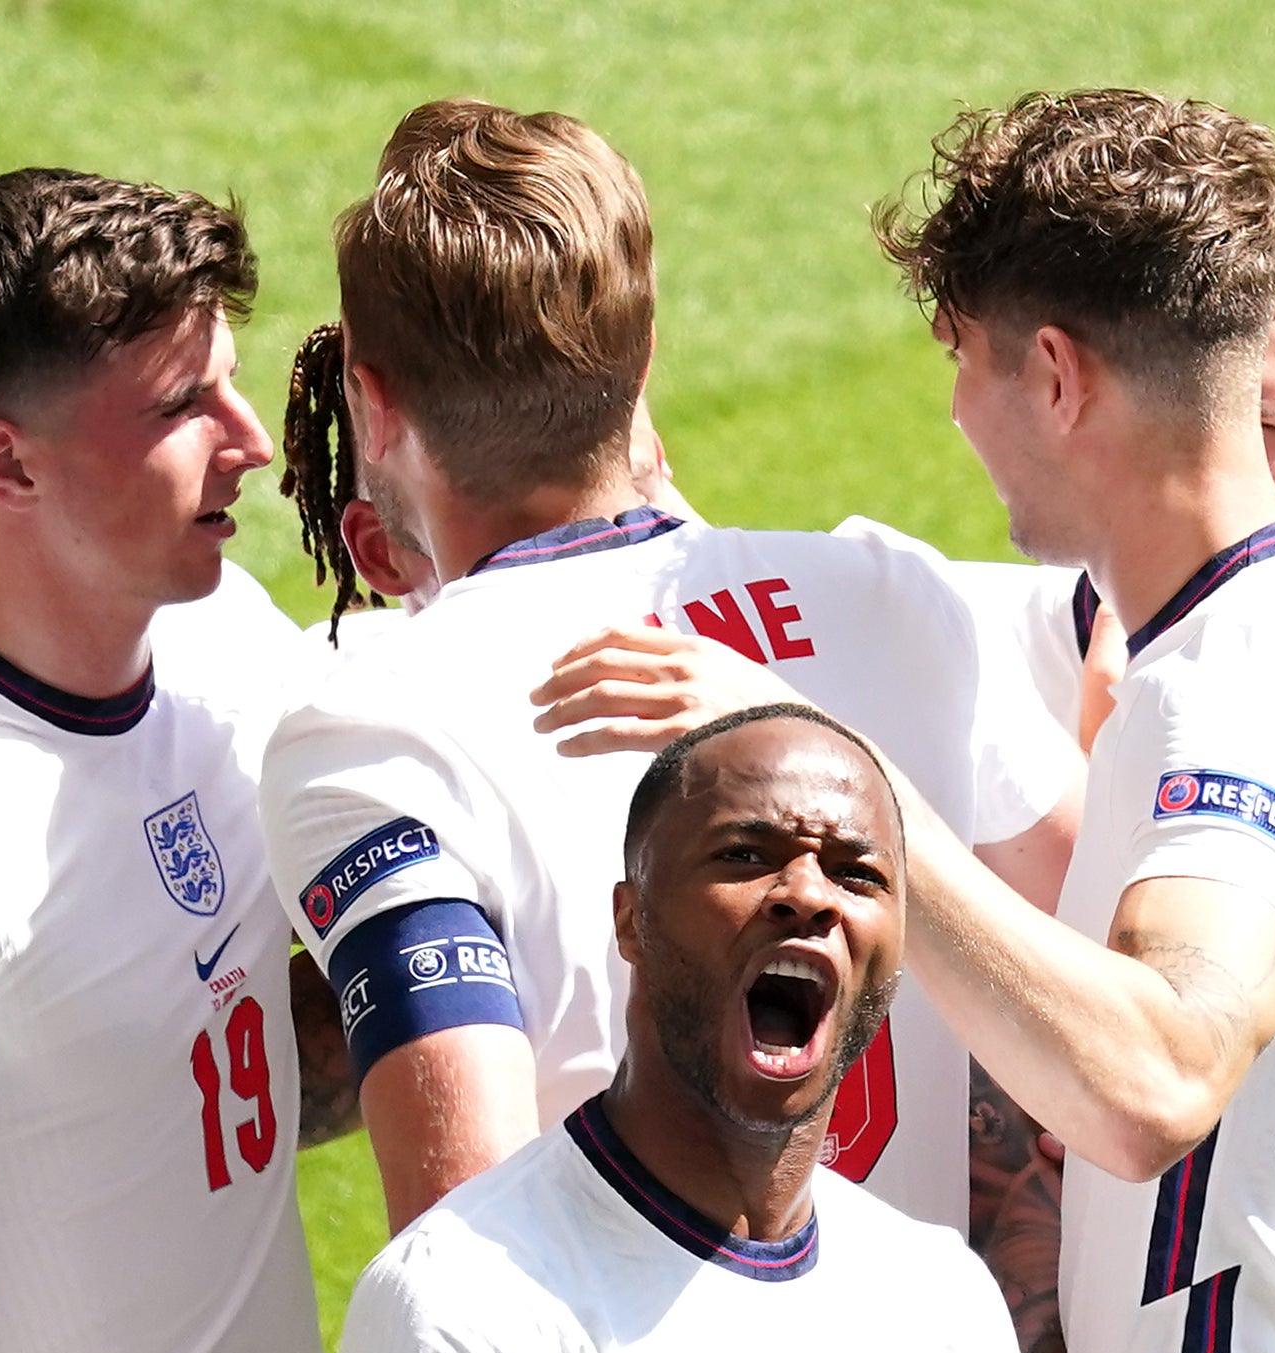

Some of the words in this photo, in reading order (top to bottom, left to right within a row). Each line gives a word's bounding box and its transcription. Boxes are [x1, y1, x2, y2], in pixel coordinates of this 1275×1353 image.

[642, 577, 816, 666] NE
[331, 826, 431, 898] RESPECT
[190, 995, 277, 1193] 19
